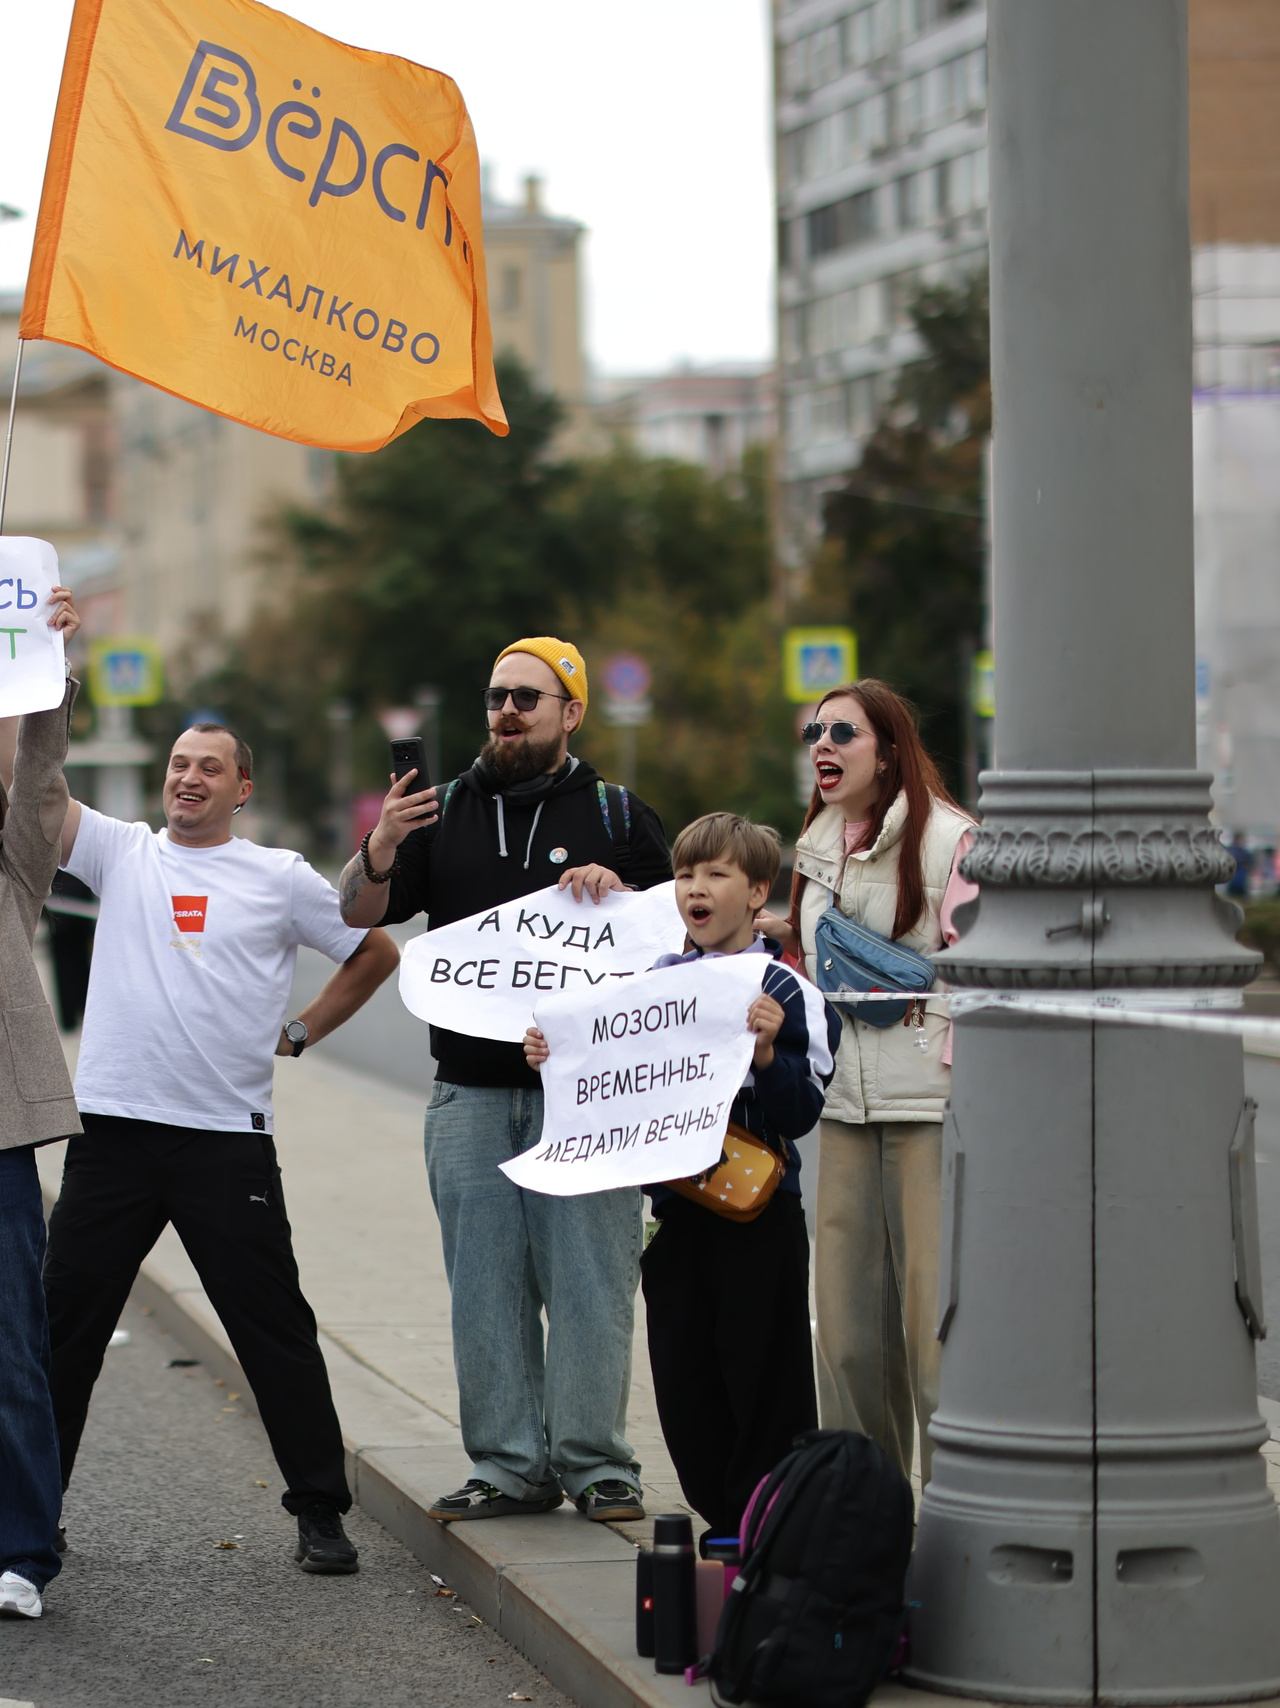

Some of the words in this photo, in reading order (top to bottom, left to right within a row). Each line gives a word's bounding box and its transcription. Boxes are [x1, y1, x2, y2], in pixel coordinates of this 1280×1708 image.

[173, 229, 440, 365] МИХАЛКОВО
[234, 315, 352, 386] МОСКВА
[477, 909, 501, 932] А
[516, 908, 615, 952] КУДА
[430, 958, 501, 989] ВСЕ
[591, 996, 697, 1045] МОЗОЛИ
[576, 1053, 714, 1106] ВРЕМЕННЫ,
[535, 1123, 641, 1164] МЕДАЛИ
